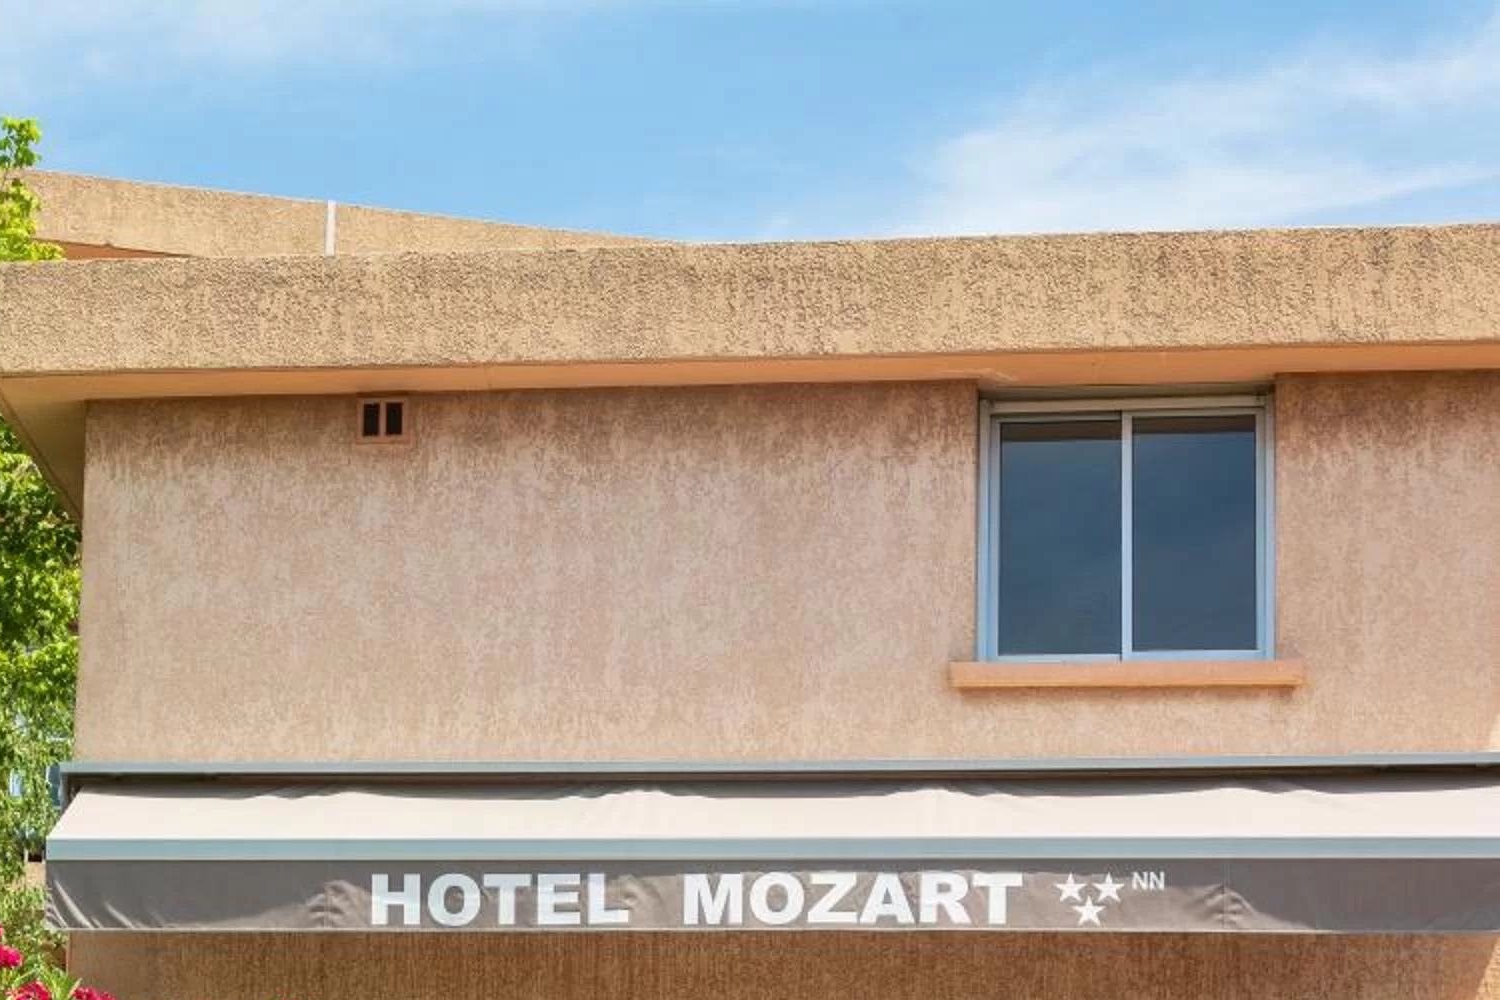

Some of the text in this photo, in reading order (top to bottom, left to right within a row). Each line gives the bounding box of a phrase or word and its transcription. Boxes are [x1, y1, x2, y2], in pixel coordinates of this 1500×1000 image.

[371, 871, 1165, 926] HOTEL MOZART NN
